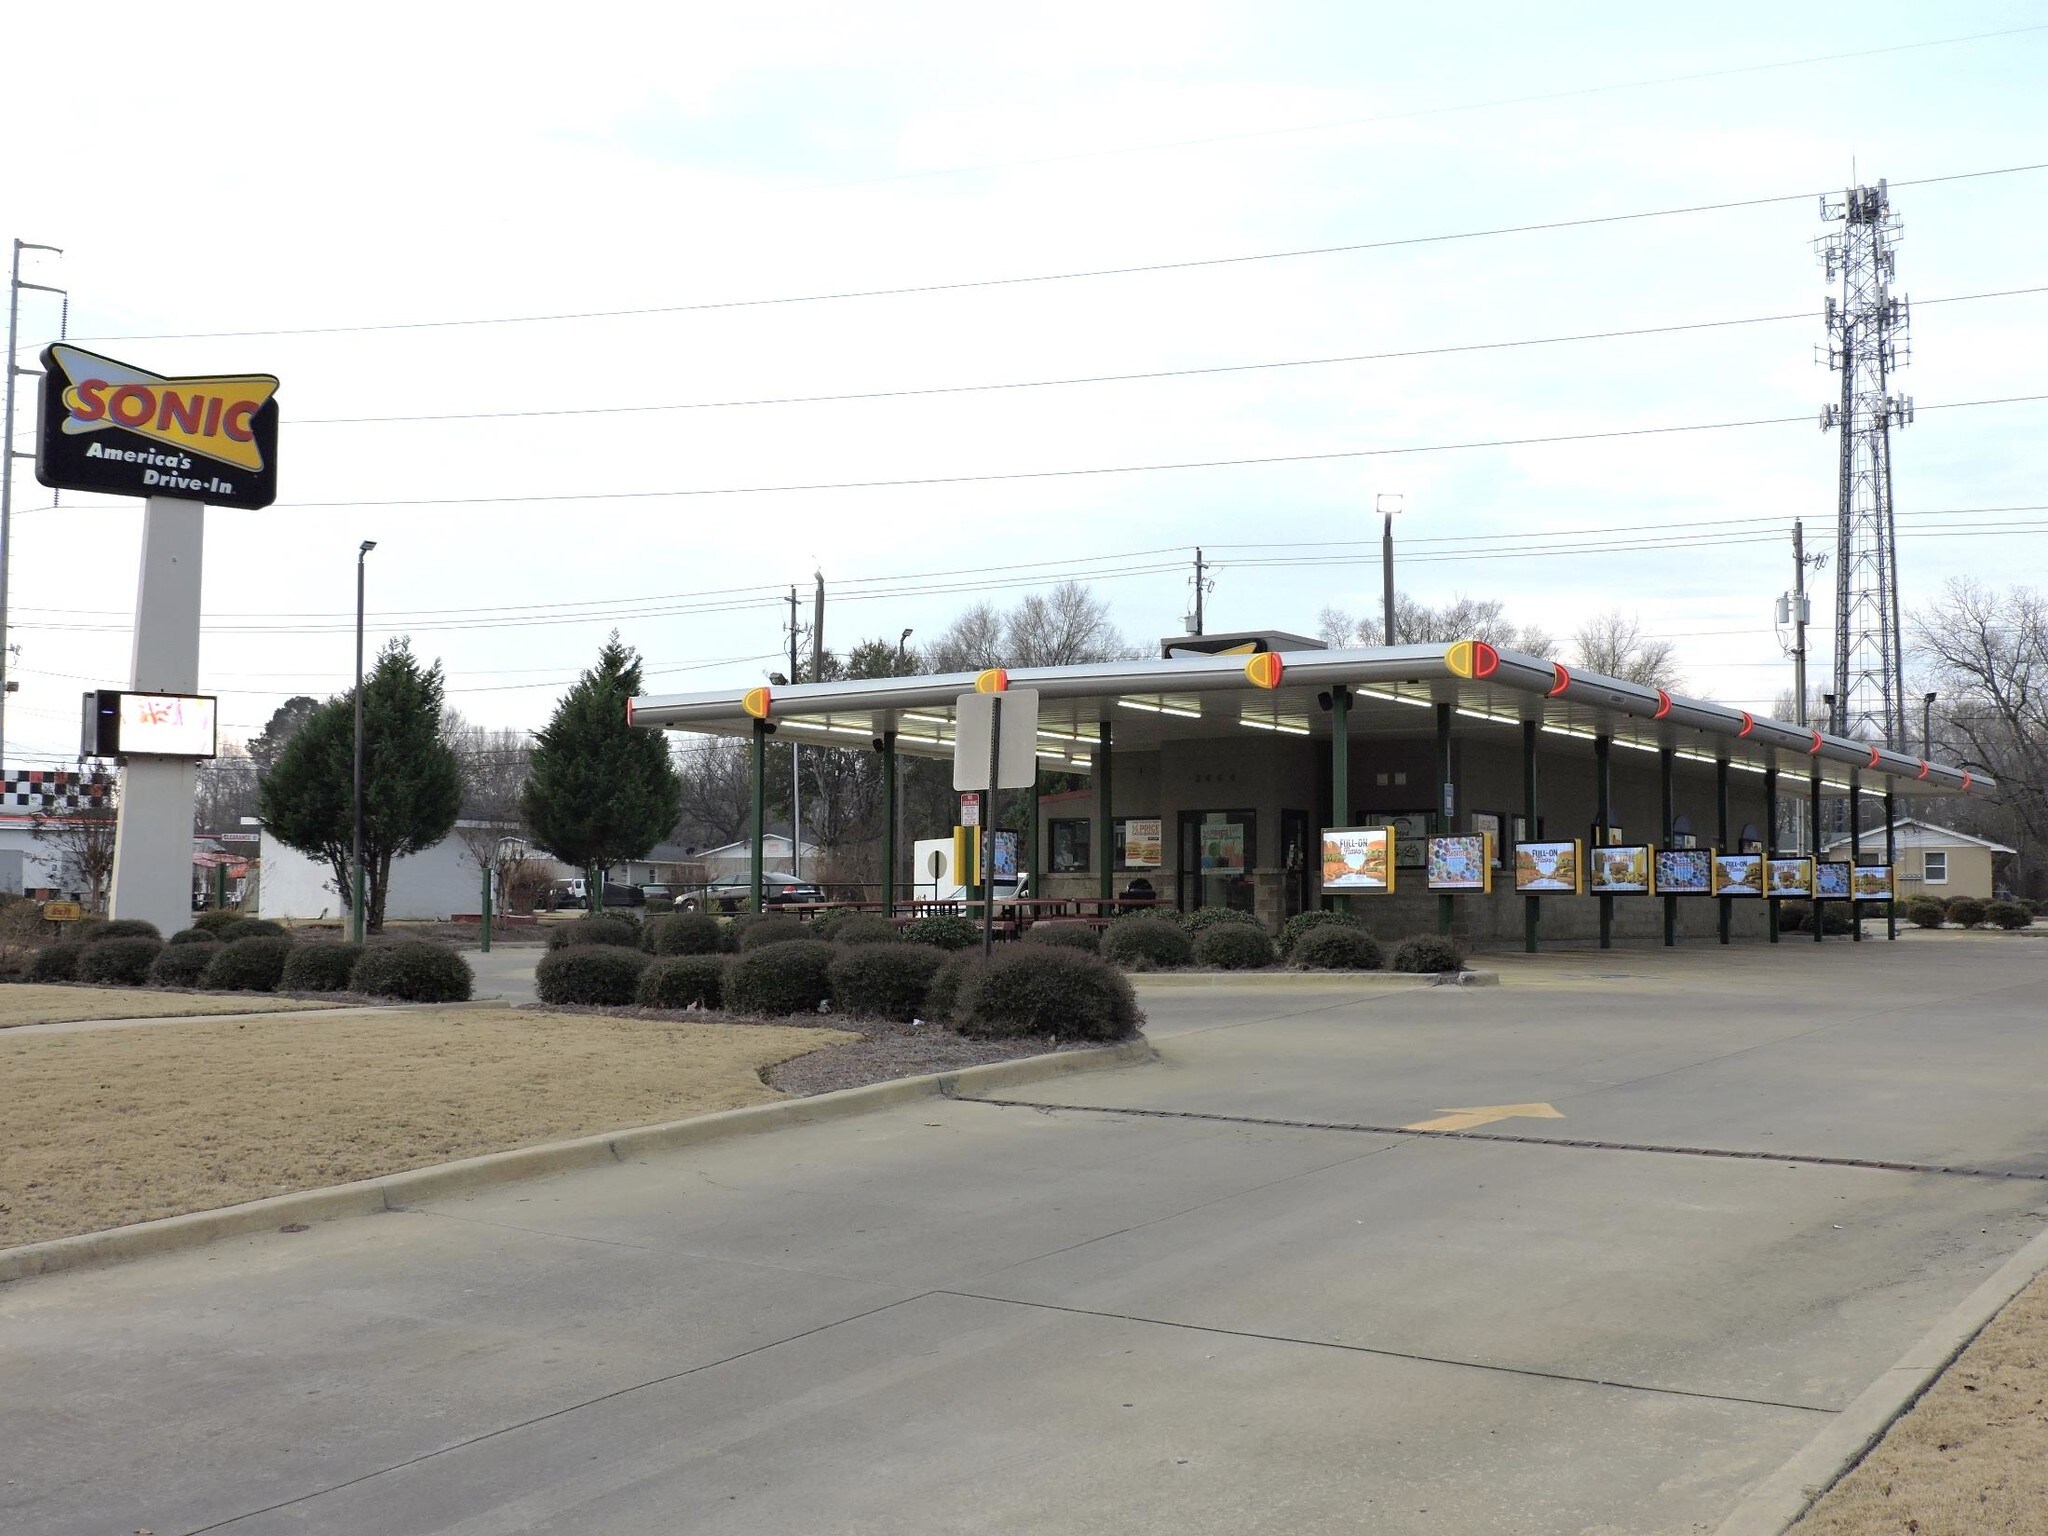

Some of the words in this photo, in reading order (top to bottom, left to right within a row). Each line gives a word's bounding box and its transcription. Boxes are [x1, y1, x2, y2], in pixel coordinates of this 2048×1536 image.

[71, 378, 262, 443] SONIC
[86, 442, 192, 470] America's
[1139, 823, 1160, 832] PRICE
[1340, 838, 1368, 848] FULL-ON
[1532, 849, 1558, 857] FULL-ON
[1725, 860, 1748, 868] FULL-ON
